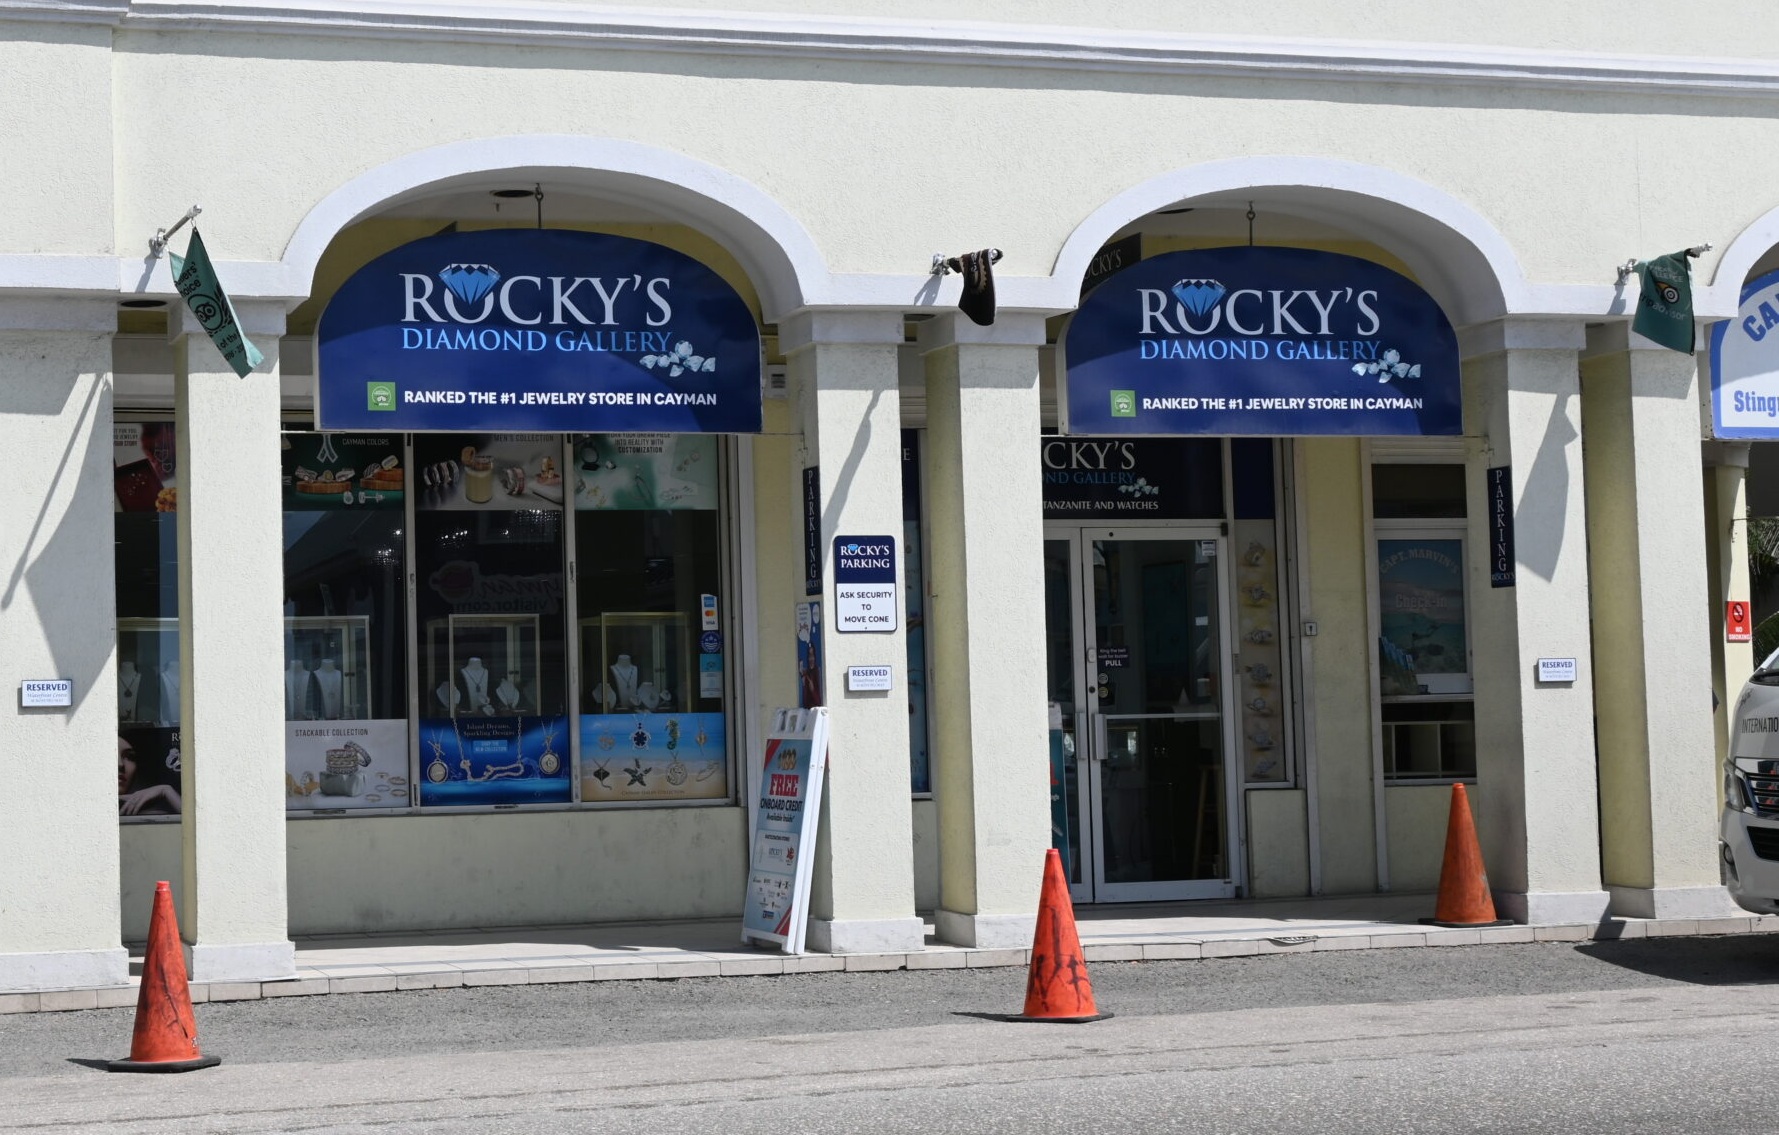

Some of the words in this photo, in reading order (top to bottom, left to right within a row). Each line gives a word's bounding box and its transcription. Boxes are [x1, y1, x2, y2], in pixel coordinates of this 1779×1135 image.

[399, 272, 672, 327] ROCKY'S
[1136, 286, 1380, 336] ROCKY'S
[1743, 294, 1779, 342] CA
[402, 328, 546, 351] DIAMOND
[556, 329, 671, 352] GALLERY
[1140, 339, 1268, 360] DIAMOND
[1276, 340, 1381, 361] GALLERY
[404, 390, 466, 404] RANKED
[468, 391, 497, 405] THE
[500, 392, 516, 405] #1
[519, 392, 586, 405] JEWELRY
[588, 392, 633, 405] STORE
[636, 392, 651, 405] IN
[653, 392, 717, 406] CAYMAN
[1142, 398, 1199, 410] RANKED
[1200, 398, 1226, 410] THE
[1228, 398, 1243, 410] #1
[1245, 398, 1306, 410] JEWELRY
[1307, 398, 1348, 410] STORE
[1350, 398, 1364, 410] IN
[1365, 398, 1423, 410] CAYMAN
[342, 438, 365, 446] CAYMAN
[367, 438, 390, 446] COLORS
[1073, 472, 1137, 484] GALLERY
[1043, 500, 1091, 510] TANZANITE
[1094, 500, 1114, 510] AND
[1117, 500, 1159, 510] WATCHES
[809, 470, 817, 579] PARKING
[1496, 470, 1507, 572] PARKING
[840, 545, 890, 556] ROCKY'S
[841, 558, 890, 568] PARKING
[856, 591, 893, 599] SECURITY
[861, 603, 872, 611] TO
[844, 615, 866, 623] MOVE
[868, 615, 889, 623] CONE
[1105, 659, 1122, 667] PULL
[1542, 661, 1573, 669] RESERVED
[852, 669, 888, 677] RESERVED
[26, 683, 68, 691] RESERVED
[1741, 717, 1779, 733] INTERNATIO
[332, 728, 368, 736] COLLECTION
[769, 773, 799, 797] FREE
[761, 798, 785, 810] ONBOARD
[785, 800, 803, 812] CREDIT
